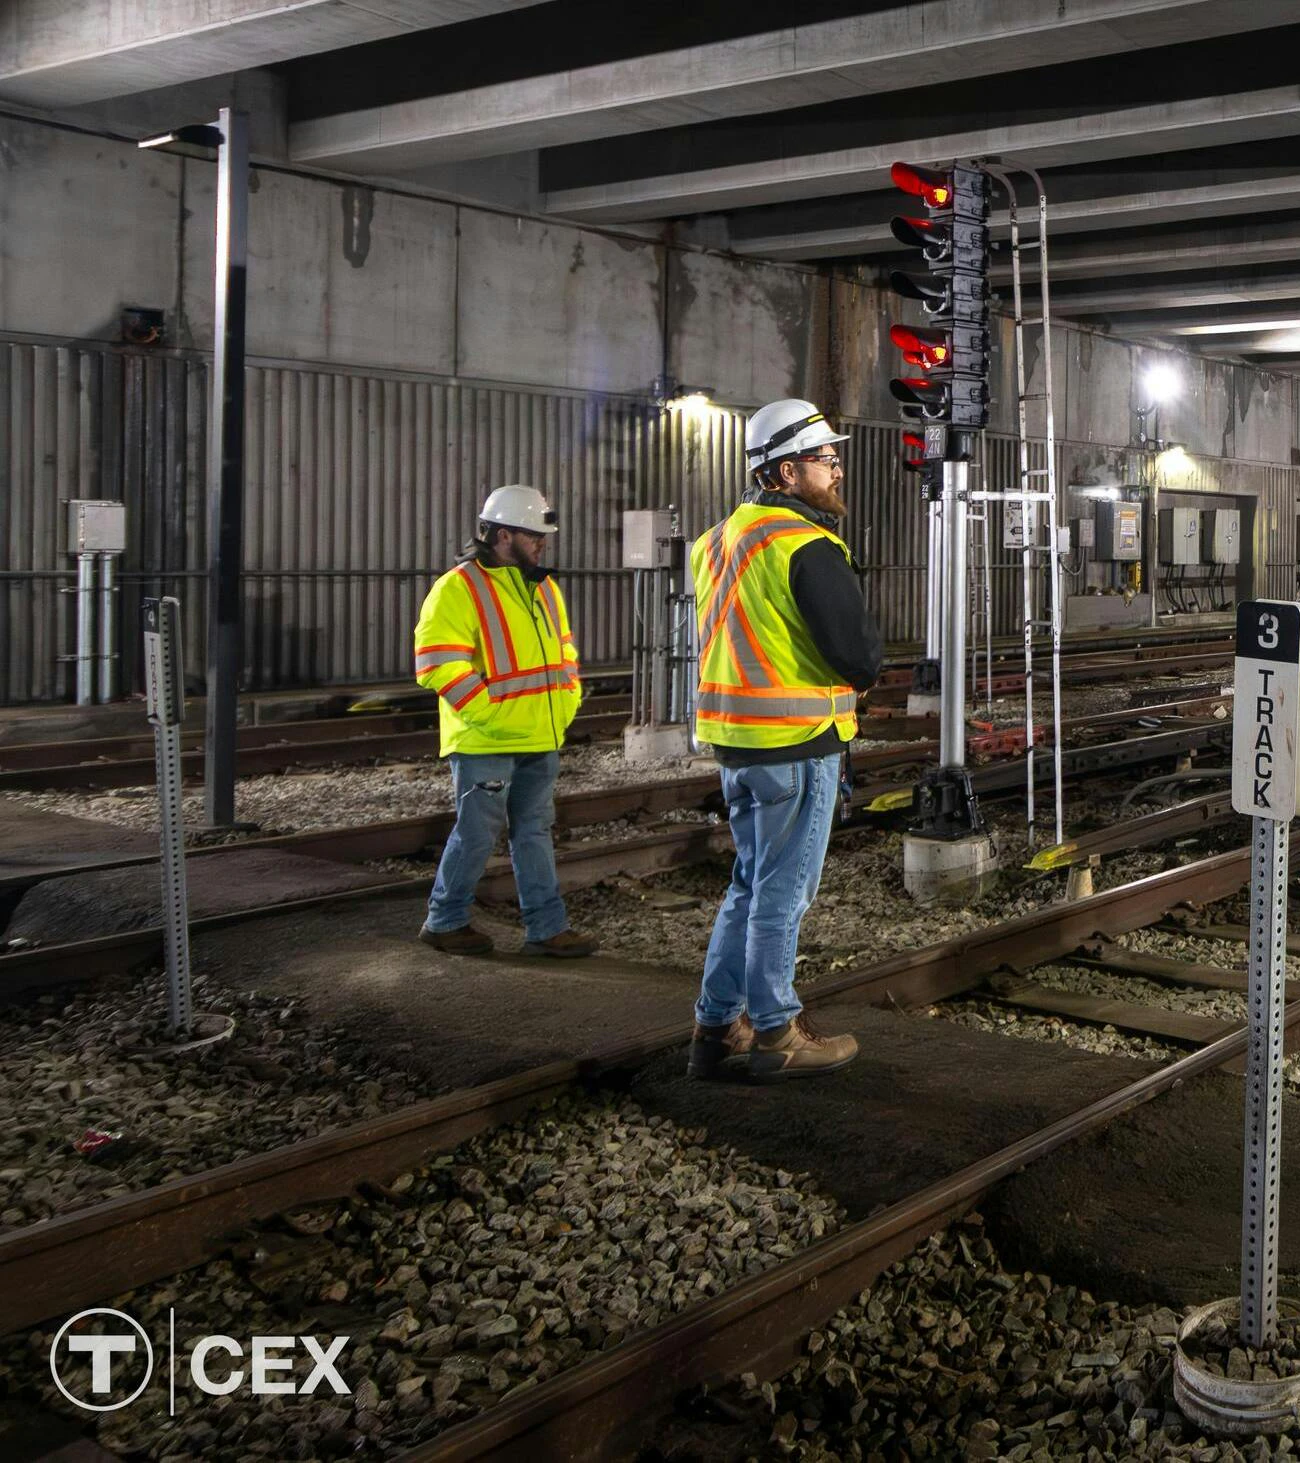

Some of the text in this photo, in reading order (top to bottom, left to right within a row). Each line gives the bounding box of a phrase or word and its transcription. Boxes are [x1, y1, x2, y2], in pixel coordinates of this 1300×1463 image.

[929, 428, 941, 441] 22
[928, 441, 941, 455] 4N
[1257, 612, 1279, 649] 3
[1253, 668, 1275, 809] TRACK
